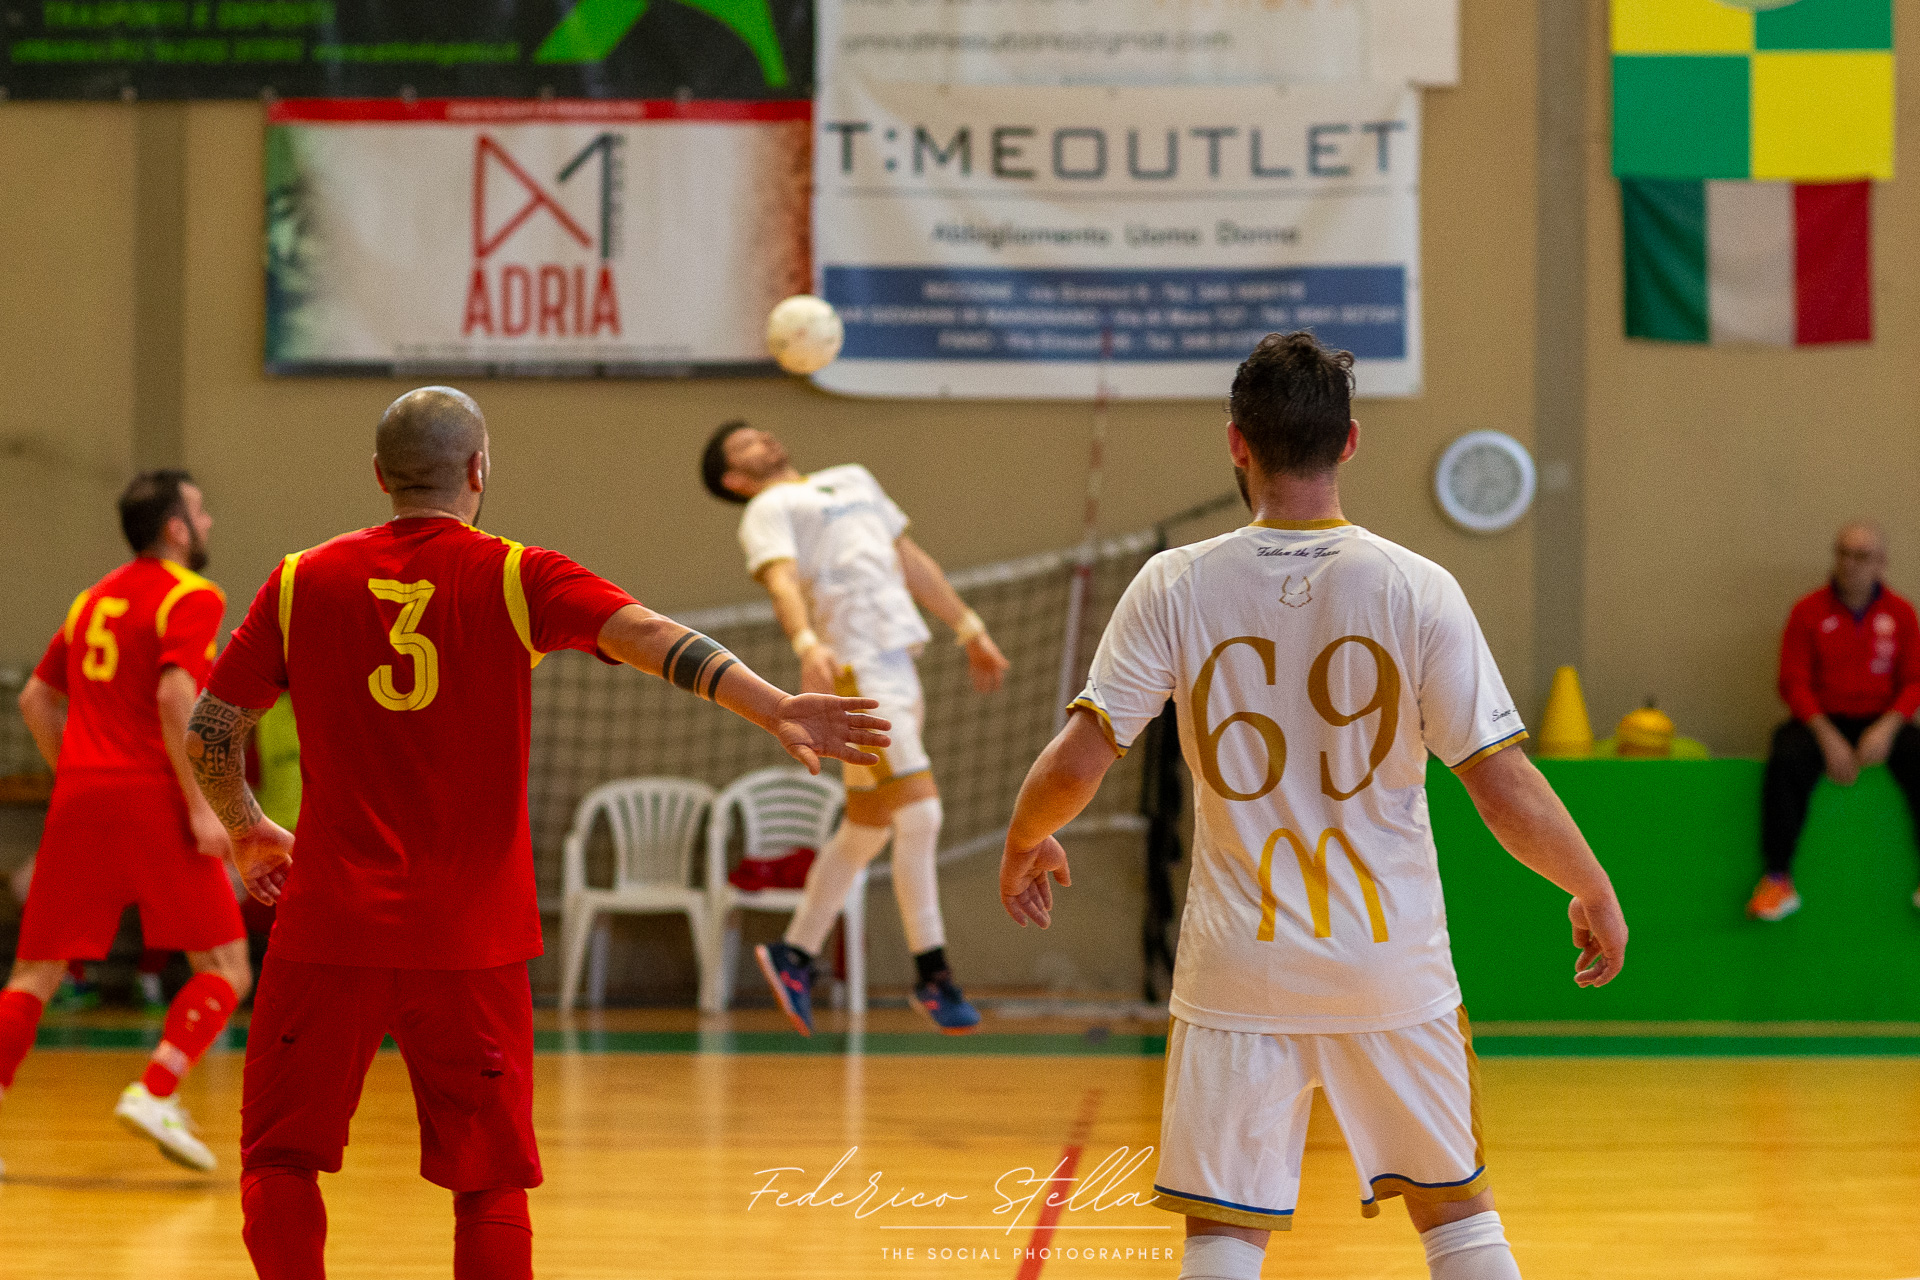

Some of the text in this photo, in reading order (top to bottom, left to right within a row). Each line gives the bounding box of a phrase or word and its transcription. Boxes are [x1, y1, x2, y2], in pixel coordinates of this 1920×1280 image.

[932, 221, 1302, 251] Abbigliamento Uomo Donna
[461, 264, 622, 338] ADRIA
[1292, 547, 1309, 557] the
[82, 596, 130, 683] 5
[367, 577, 439, 712] 3
[1191, 634, 1401, 803] 69
